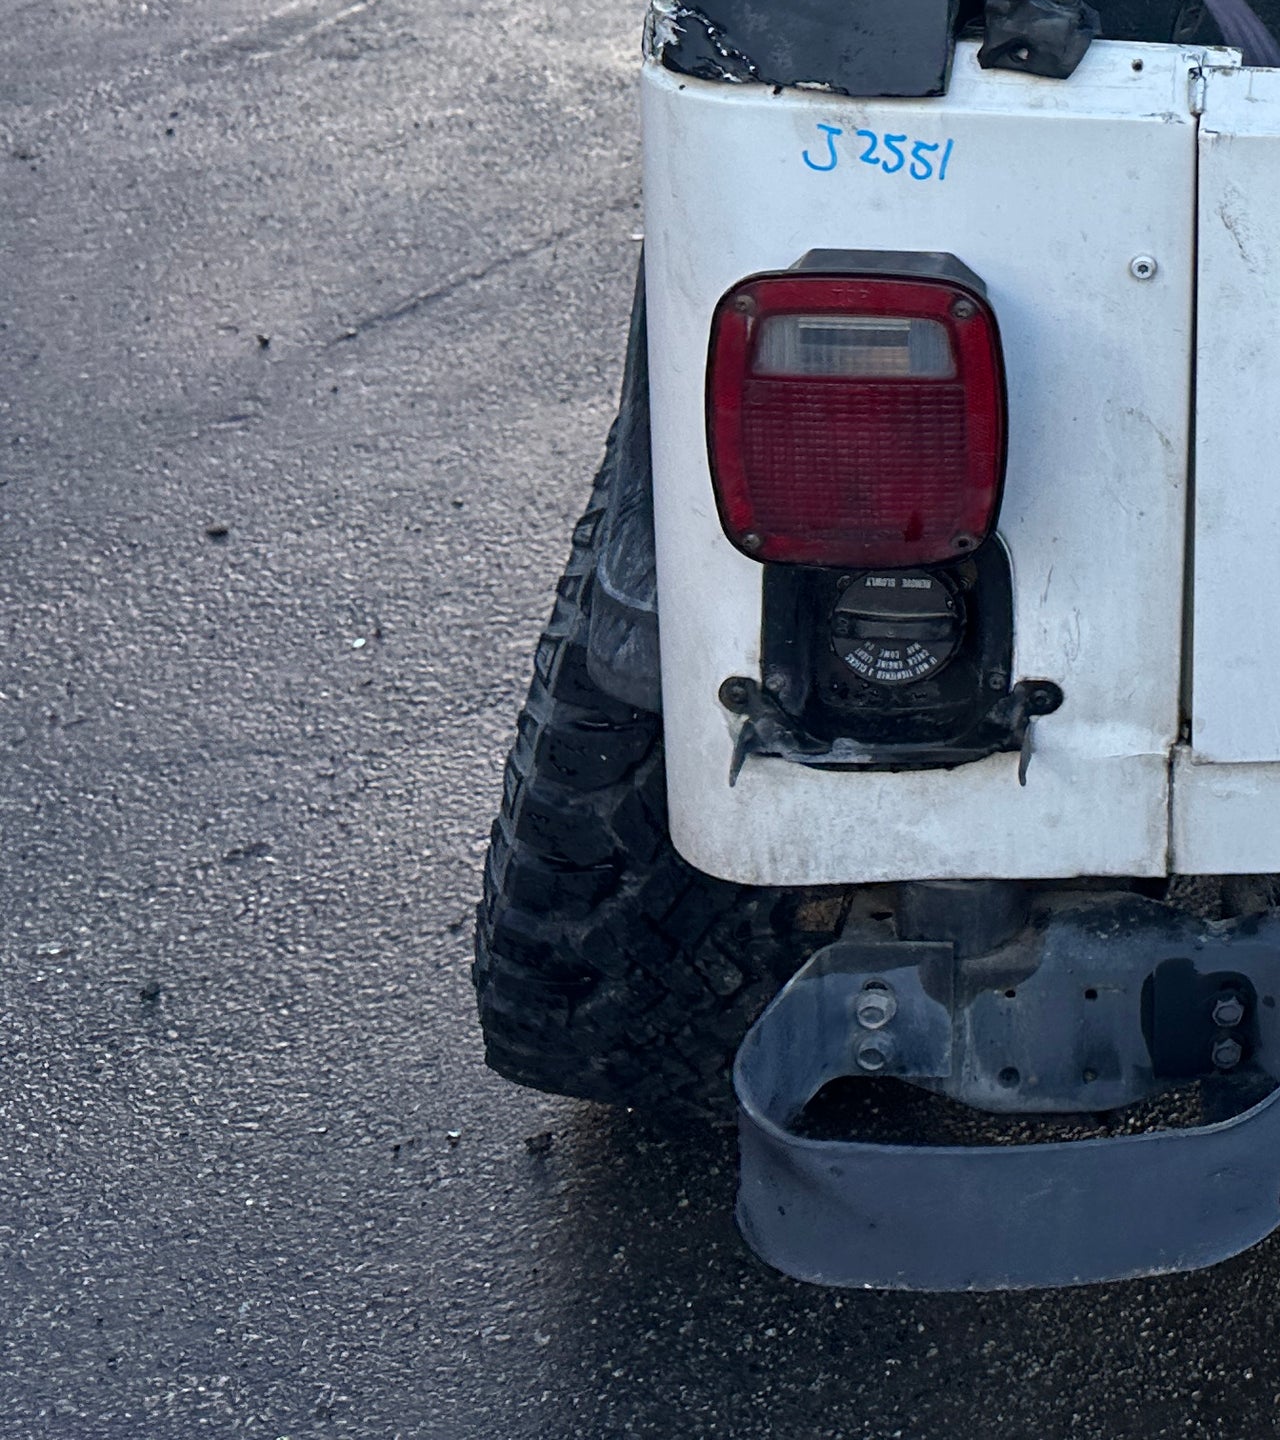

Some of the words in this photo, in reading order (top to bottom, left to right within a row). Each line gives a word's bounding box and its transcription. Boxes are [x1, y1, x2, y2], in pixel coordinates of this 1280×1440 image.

[802, 122, 955, 182] J2551
[865, 577, 896, 588] SLOWLY
[901, 578, 931, 588] REMOVE
[853, 647, 873, 664] LIGHT
[878, 648, 900, 659] COME
[906, 649, 929, 666] CHECK
[843, 652, 868, 672] CLICKS
[875, 659, 903, 669] ENGINE
[915, 662, 929, 674] NOT
[876, 669, 913, 680] TIGHTENED
